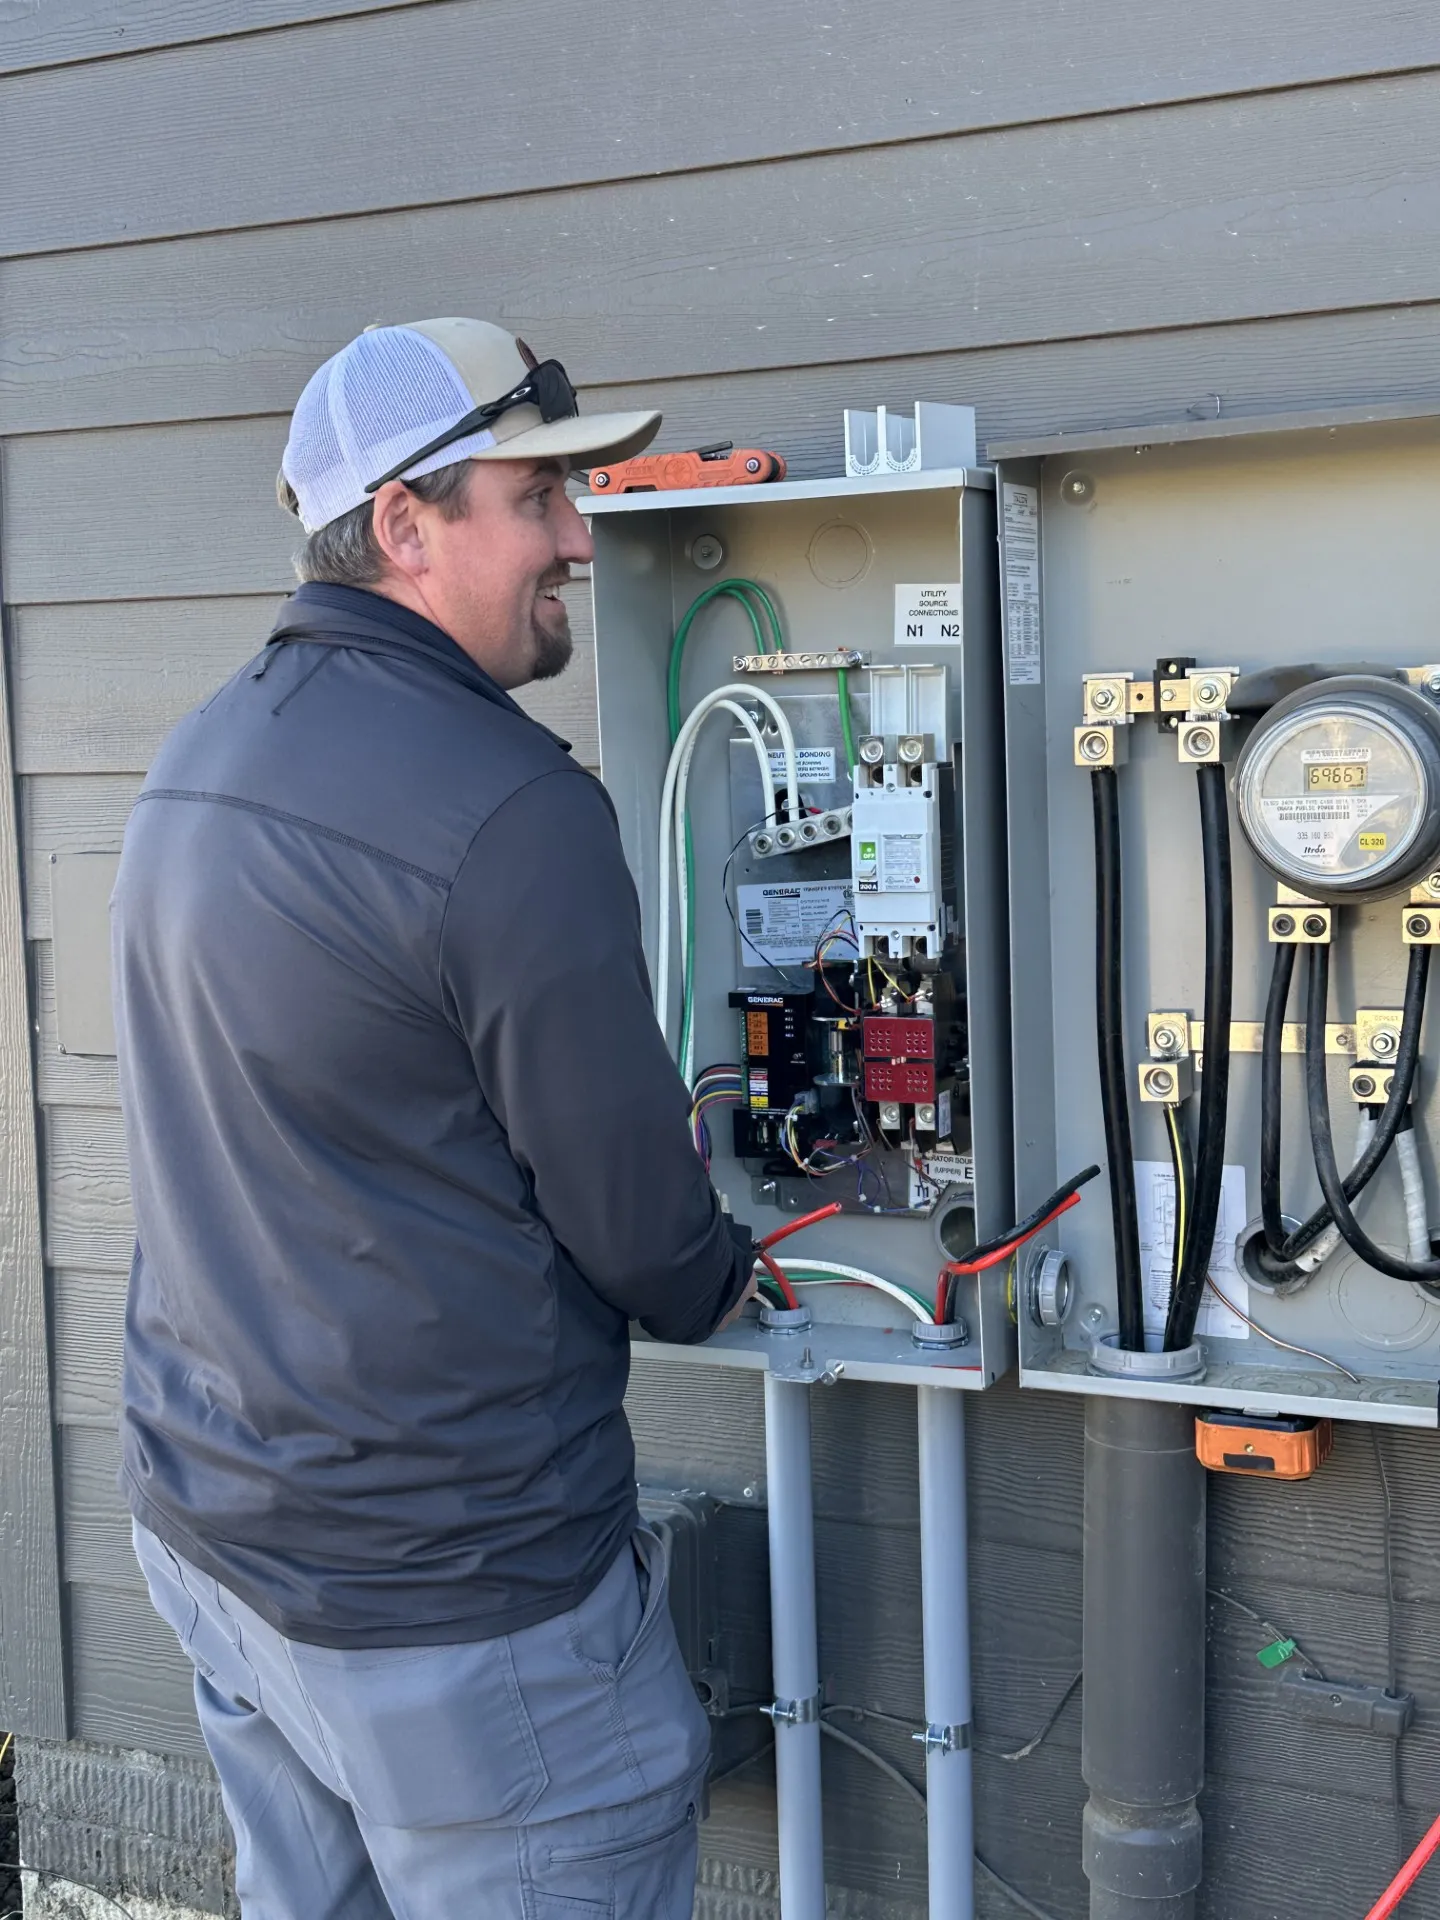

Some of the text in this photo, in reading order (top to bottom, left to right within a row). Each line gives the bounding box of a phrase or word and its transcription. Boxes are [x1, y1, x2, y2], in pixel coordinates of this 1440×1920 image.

[921, 590, 947, 598] UTILITY
[908, 609, 959, 617] CONNECTIONS
[906, 624, 960, 637] N1 N2
[767, 751, 799, 759] NEUTL
[1310, 767, 1364, 784] 69667
[1360, 838, 1385, 846] CL 320
[1304, 844, 1326, 854] Itron
[762, 887, 801, 896] GENERAC
[747, 996, 784, 1004] GENERAC
[935, 1166, 961, 1176] (UPPER)
